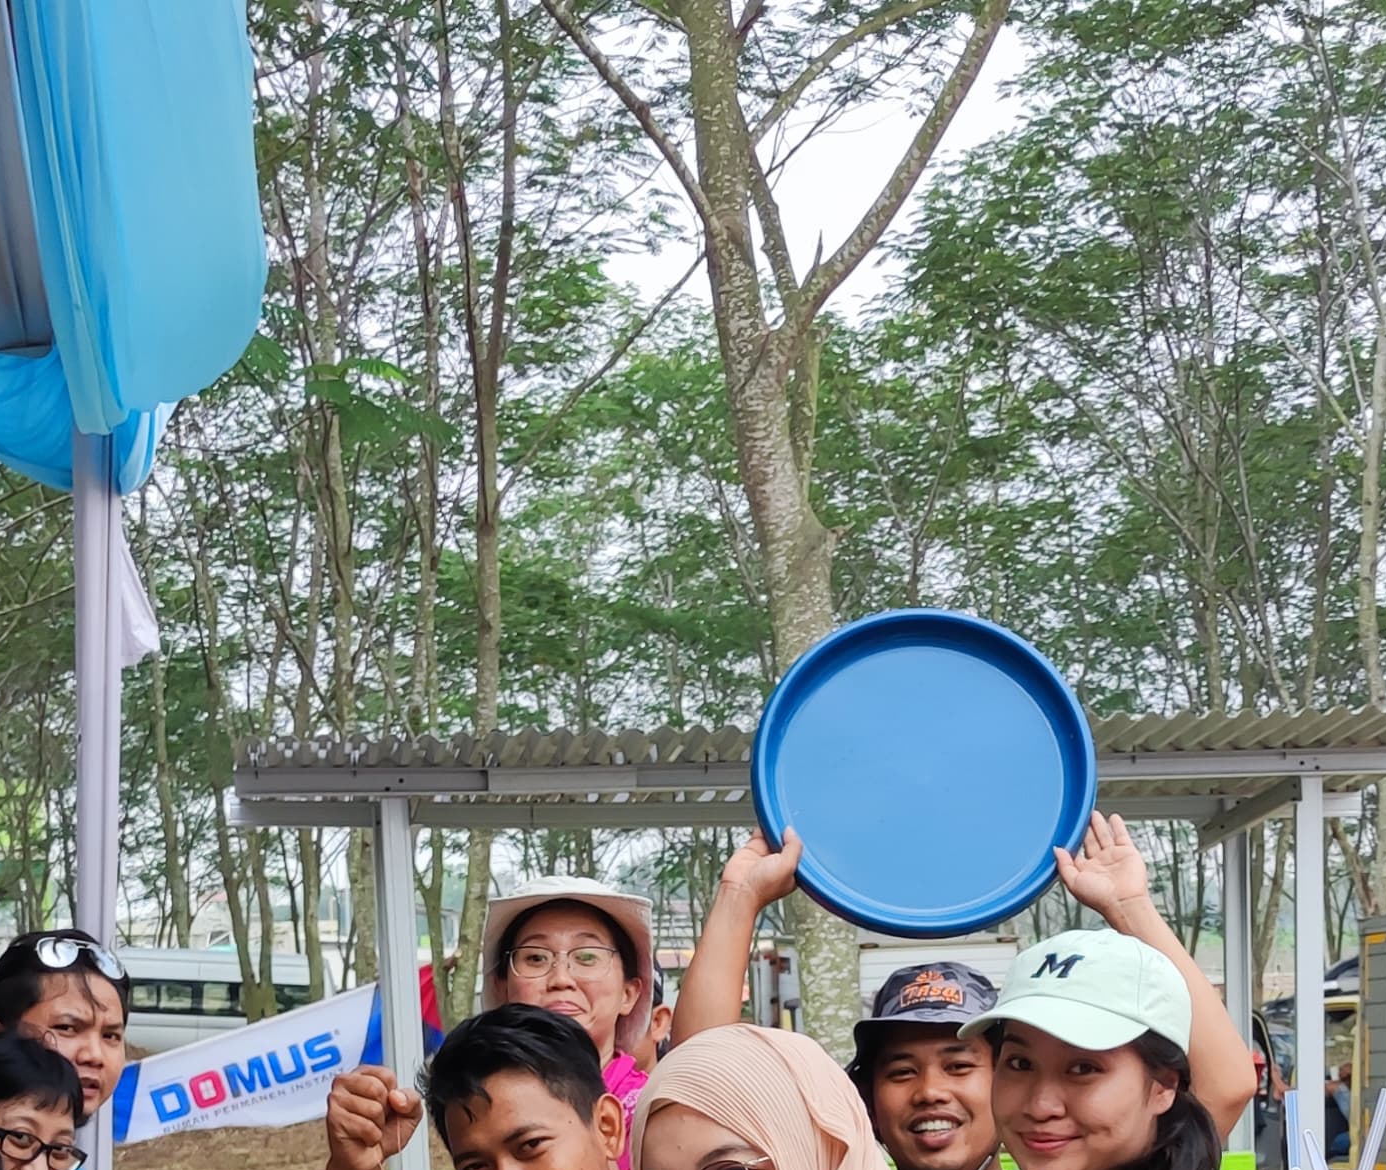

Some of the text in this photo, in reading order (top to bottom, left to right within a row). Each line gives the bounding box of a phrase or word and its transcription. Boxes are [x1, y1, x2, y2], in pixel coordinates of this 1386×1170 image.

[1030, 952, 1085, 979] M
[150, 1031, 342, 1124] DOMUS
[163, 1113, 210, 1134] RUMAH
[214, 1089, 287, 1117] PERMANEN
